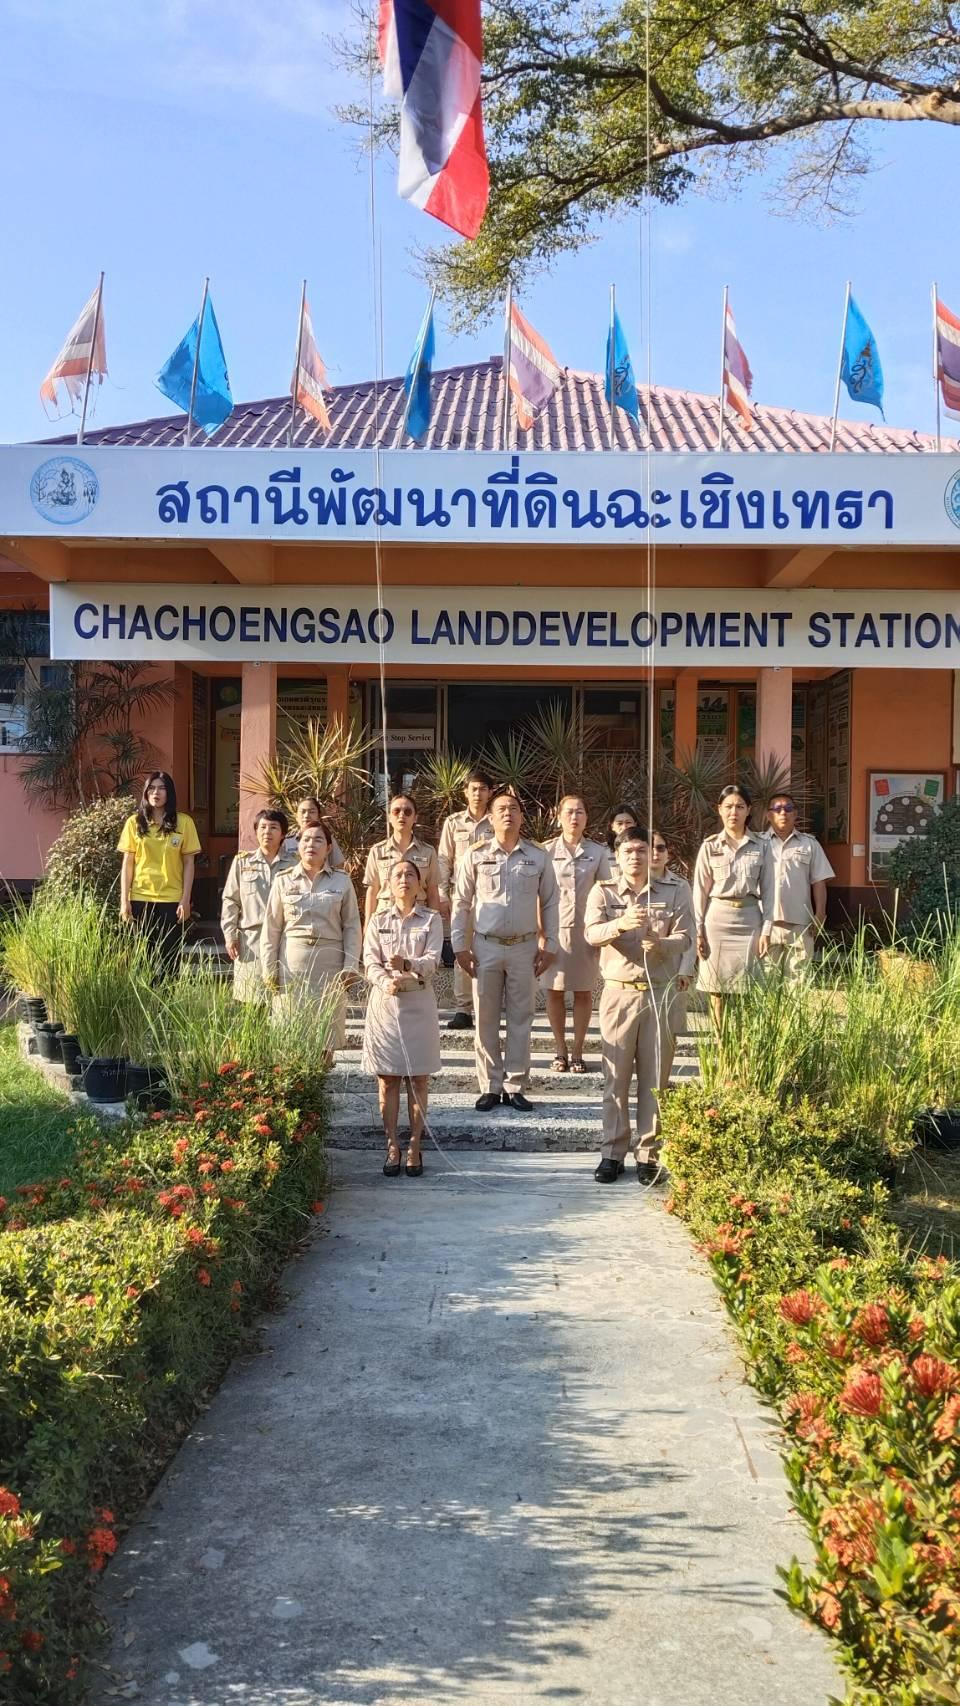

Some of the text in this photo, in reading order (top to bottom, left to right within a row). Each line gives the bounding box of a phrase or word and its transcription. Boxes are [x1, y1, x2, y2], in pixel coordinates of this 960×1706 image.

[156, 455, 894, 530] สถานีพัฒนาที่ดินฉะเชิงเทรา
[74, 602, 960, 649] CHACHOENGSAO LANDDEVELOPMENT STATION
[391, 734, 406, 743] Stop
[408, 734, 432, 742] Service
